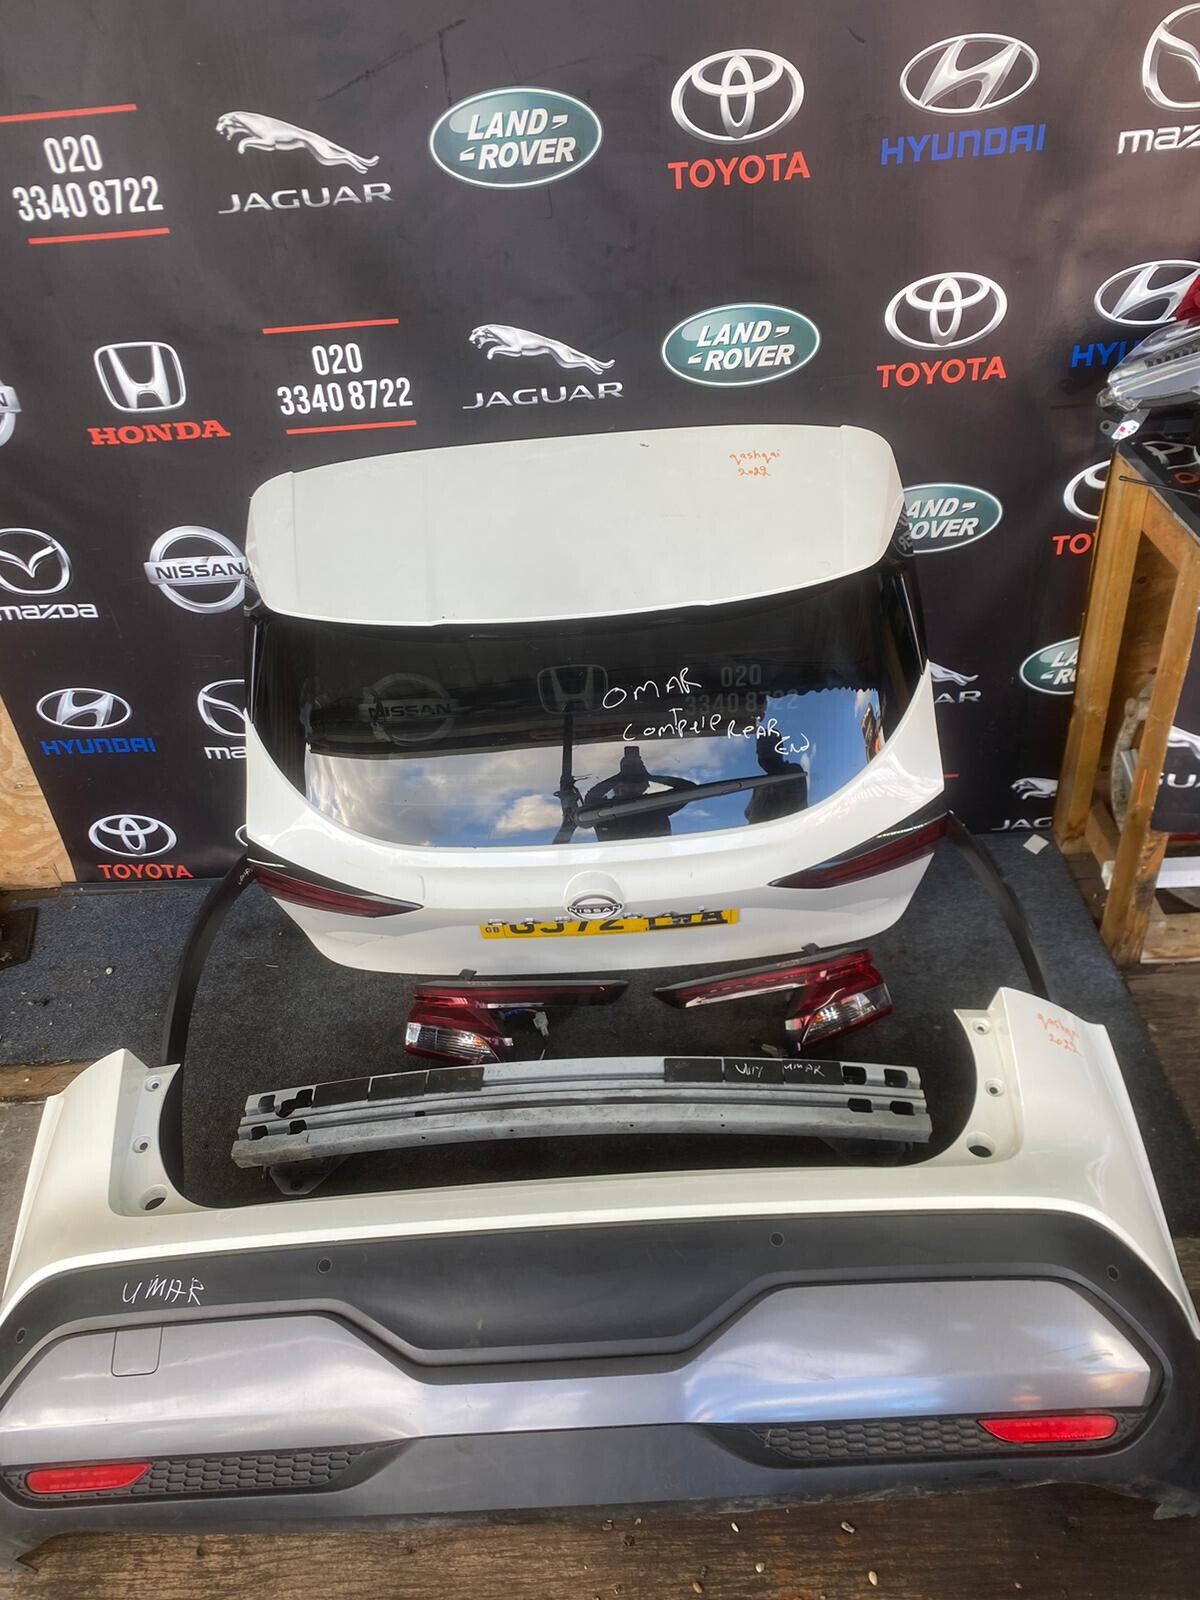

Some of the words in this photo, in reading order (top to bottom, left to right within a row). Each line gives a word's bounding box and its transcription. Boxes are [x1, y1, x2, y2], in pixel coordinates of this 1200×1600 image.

[467, 108, 549, 141] LAND
[43, 134, 103, 174] 020
[478, 137, 577, 170] ROVER
[880, 123, 1046, 166] HYUNDAI
[668, 151, 811, 190] TOYOTA
[12, 182, 88, 221] 3340
[88, 175, 164, 216] 8722
[218, 182, 393, 214] JAGUAR
[696, 320, 773, 348] LAND
[311, 342, 364, 376] 020
[703, 343, 795, 372] ROVER
[876, 355, 1007, 389] TOYOTA
[276, 382, 345, 416] 3340
[347, 376, 413, 411] 8722
[462, 381, 624, 410] JAGUAR
[87, 419, 231, 446] HONDA
[906, 497, 960, 519] AND
[909, 516, 980, 540] OVER
[155, 562, 245, 580] NISSAN
[720, 663, 762, 688] 020
[39, 736, 157, 758] HYUNDAI
[98, 863, 194, 881] TOYOTA
[567, 902, 622, 914] NISSAN
[121, 1273, 205, 1306] UMAR
